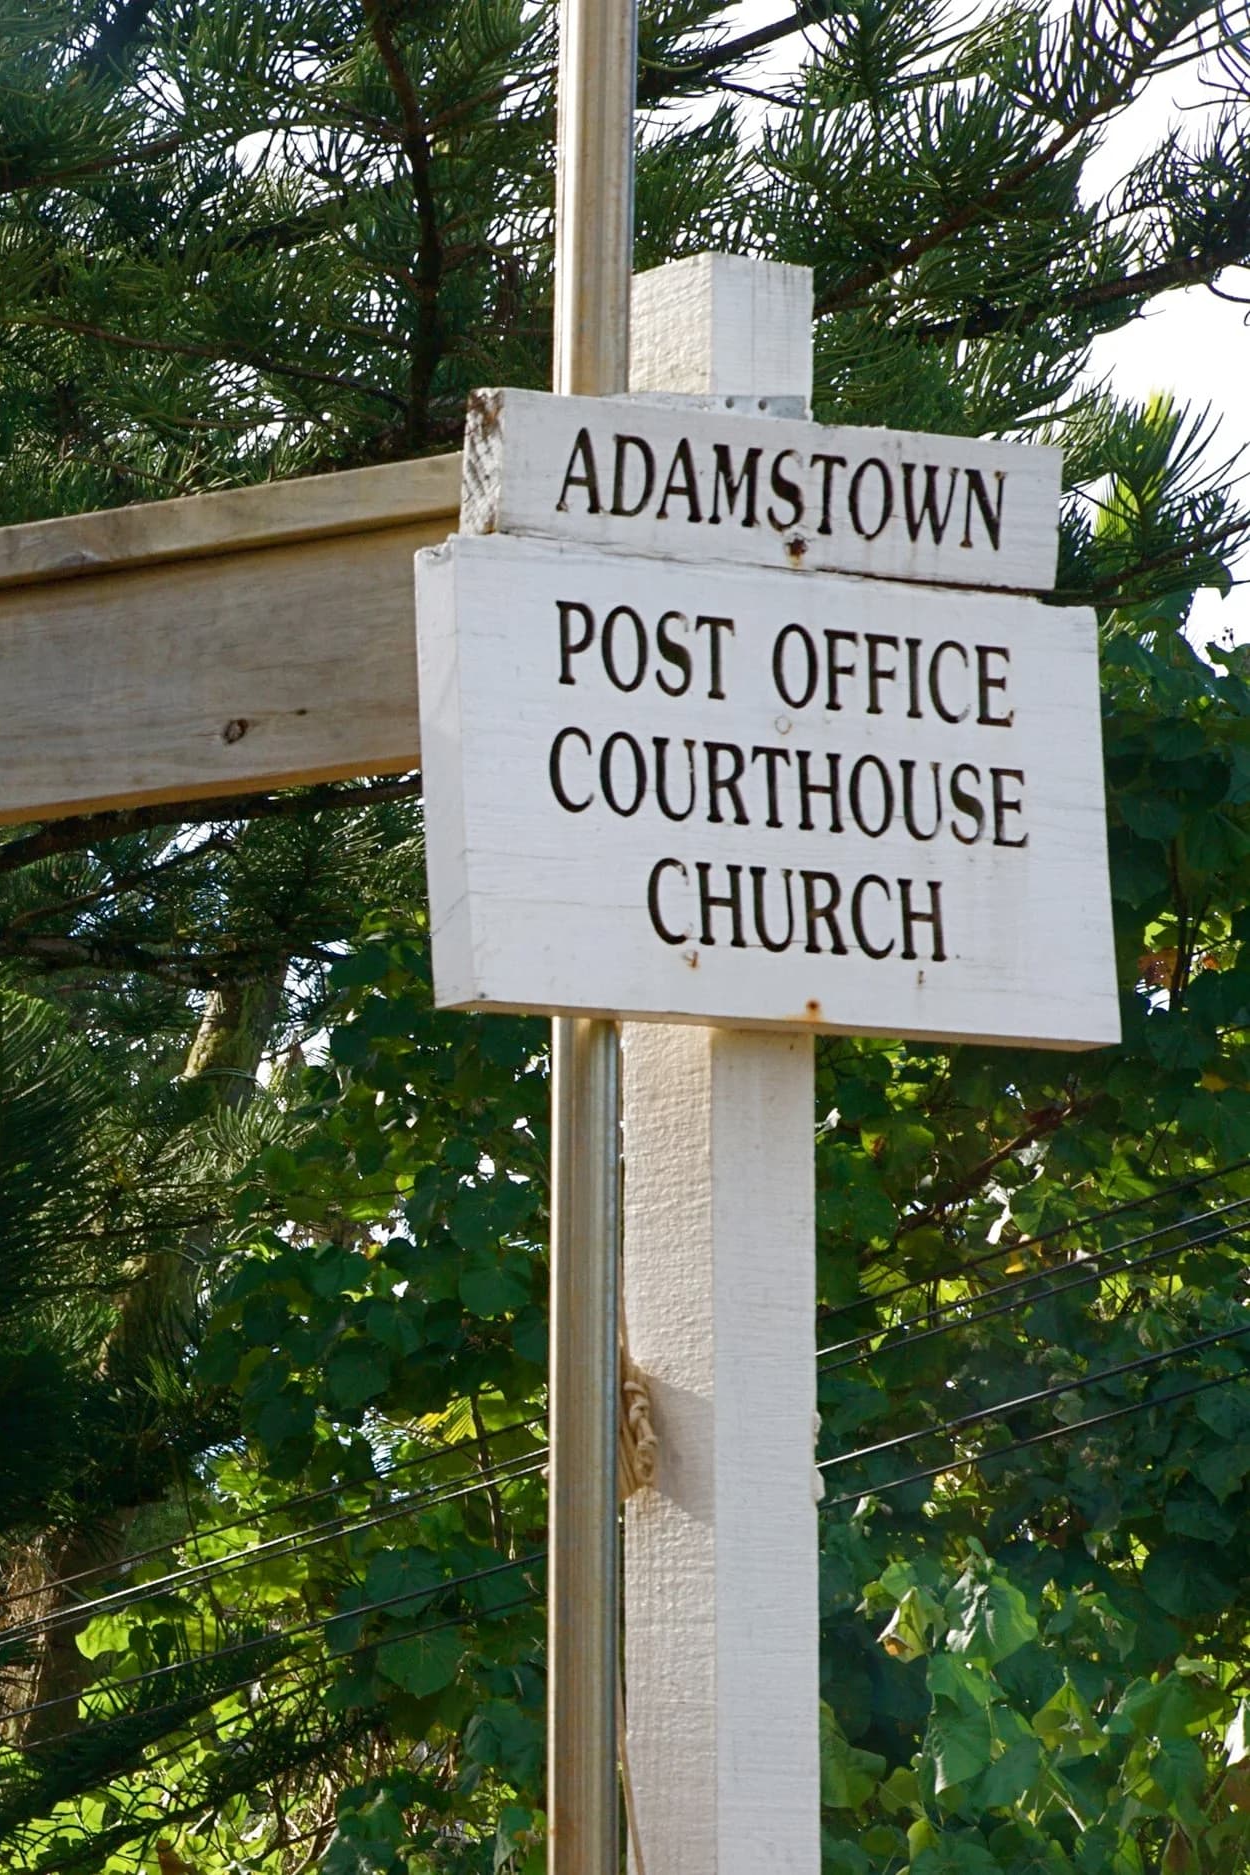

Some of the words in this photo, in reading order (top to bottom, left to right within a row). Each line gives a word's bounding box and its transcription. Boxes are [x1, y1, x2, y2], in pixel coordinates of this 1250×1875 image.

[556, 427, 1006, 550] ADAMSTOWN
[556, 601, 734, 699] POST
[773, 624, 1015, 727] OFFICE
[550, 727, 1029, 848] COURTHOUSE
[648, 859, 947, 962] CHURCH
